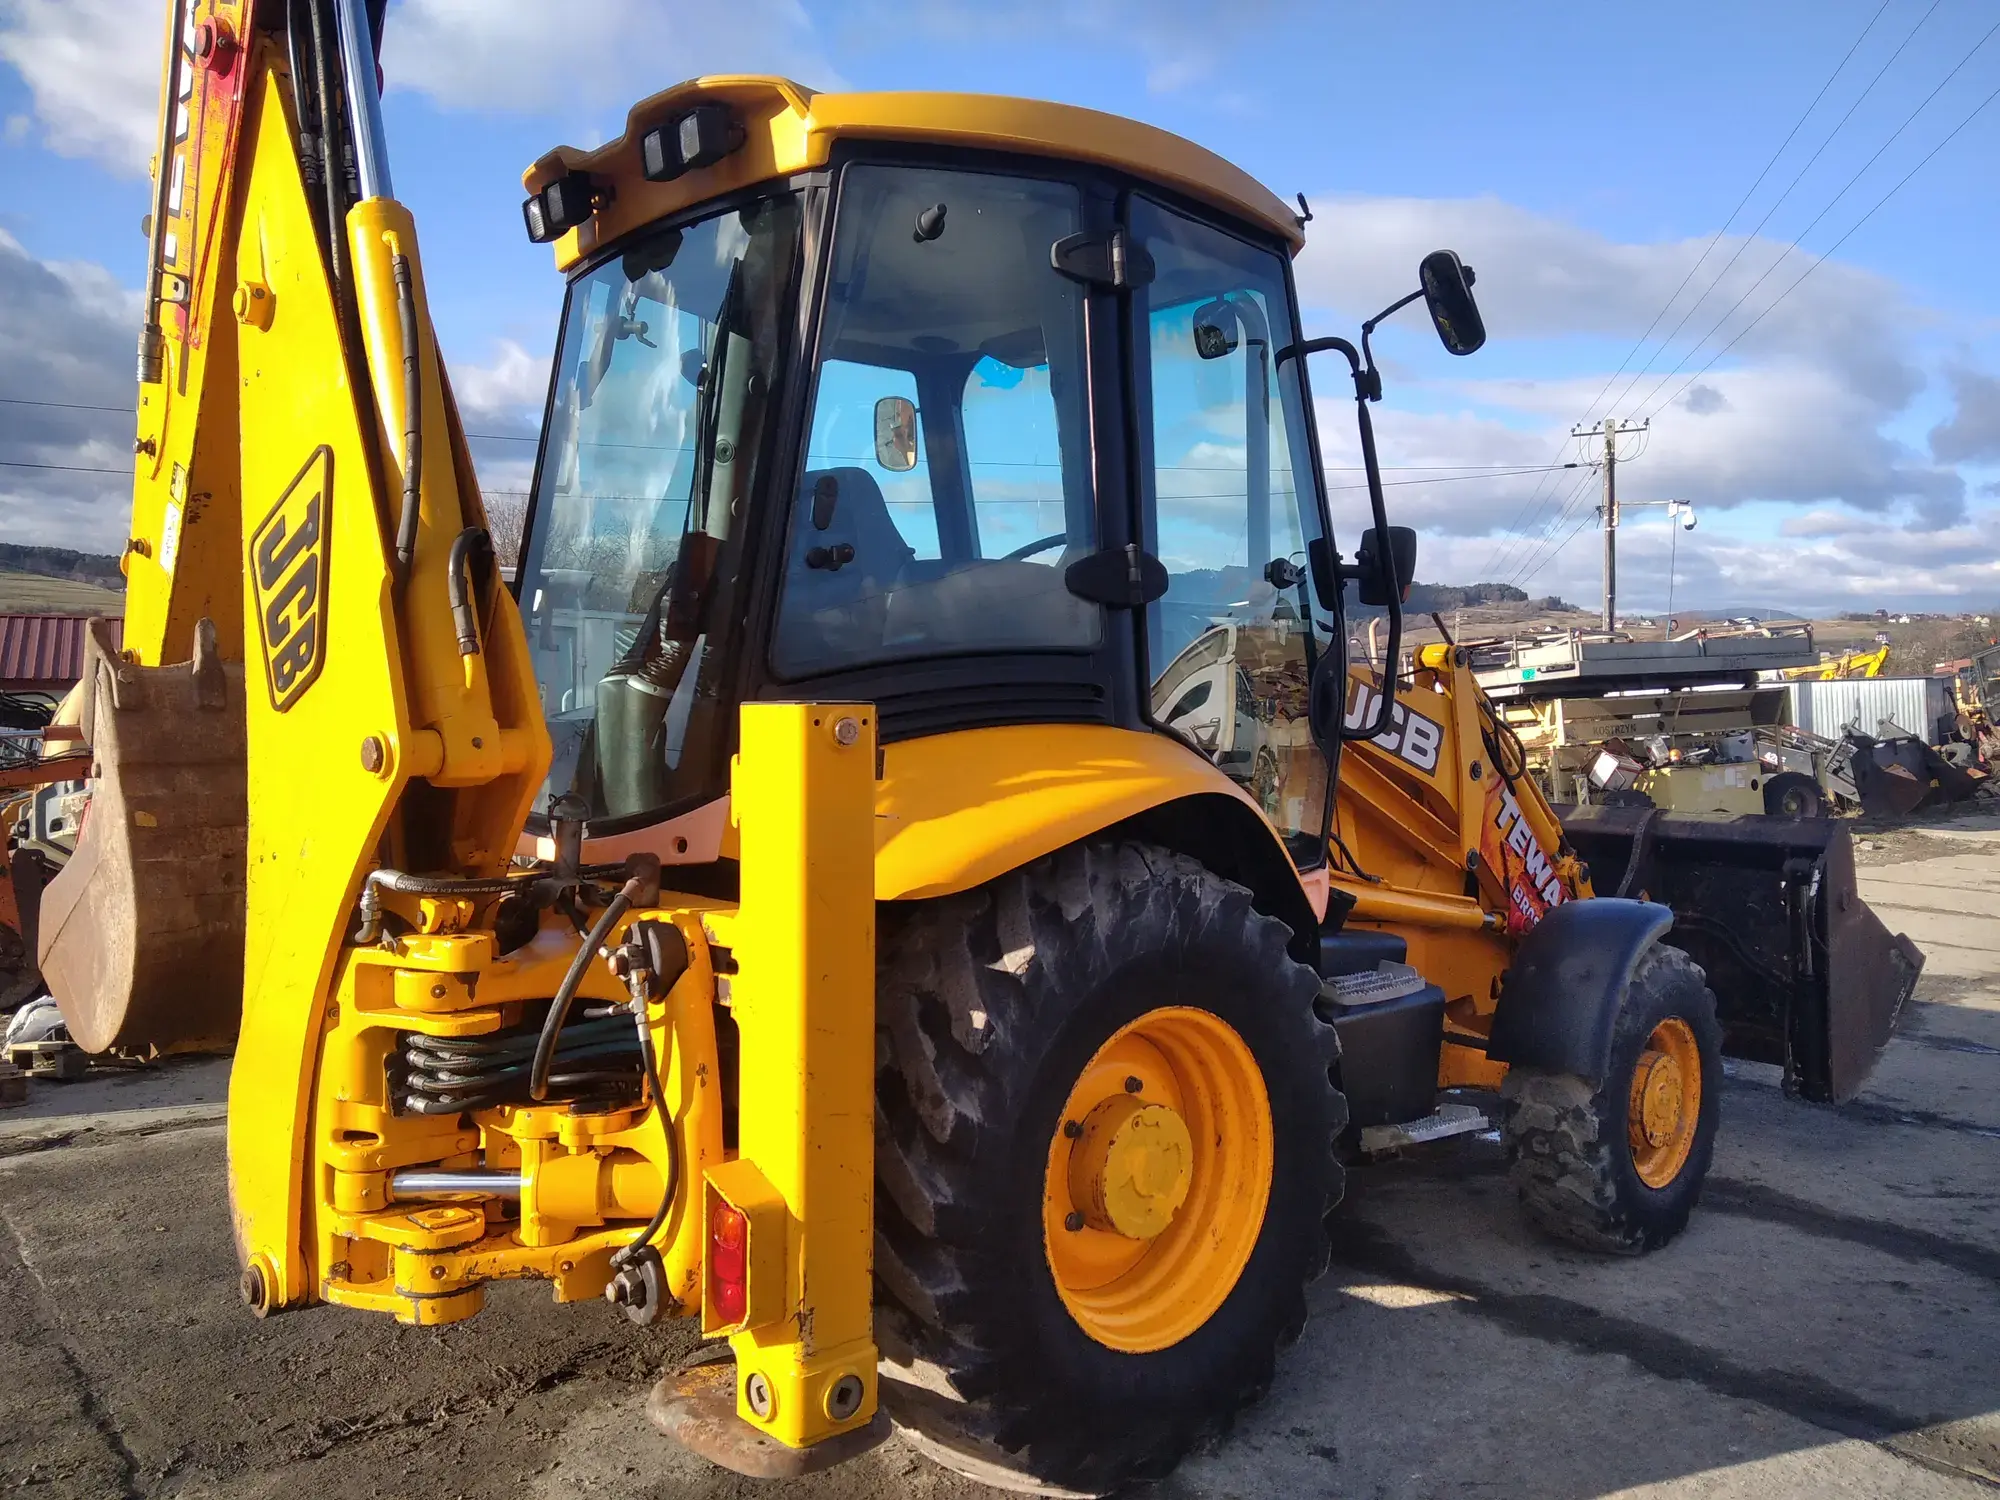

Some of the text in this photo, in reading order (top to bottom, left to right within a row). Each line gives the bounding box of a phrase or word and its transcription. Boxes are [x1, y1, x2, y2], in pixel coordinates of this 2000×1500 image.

[258, 491, 321, 693] JCB
[1345, 683, 1441, 771] JCB
[1497, 788, 1570, 907] TEWA
